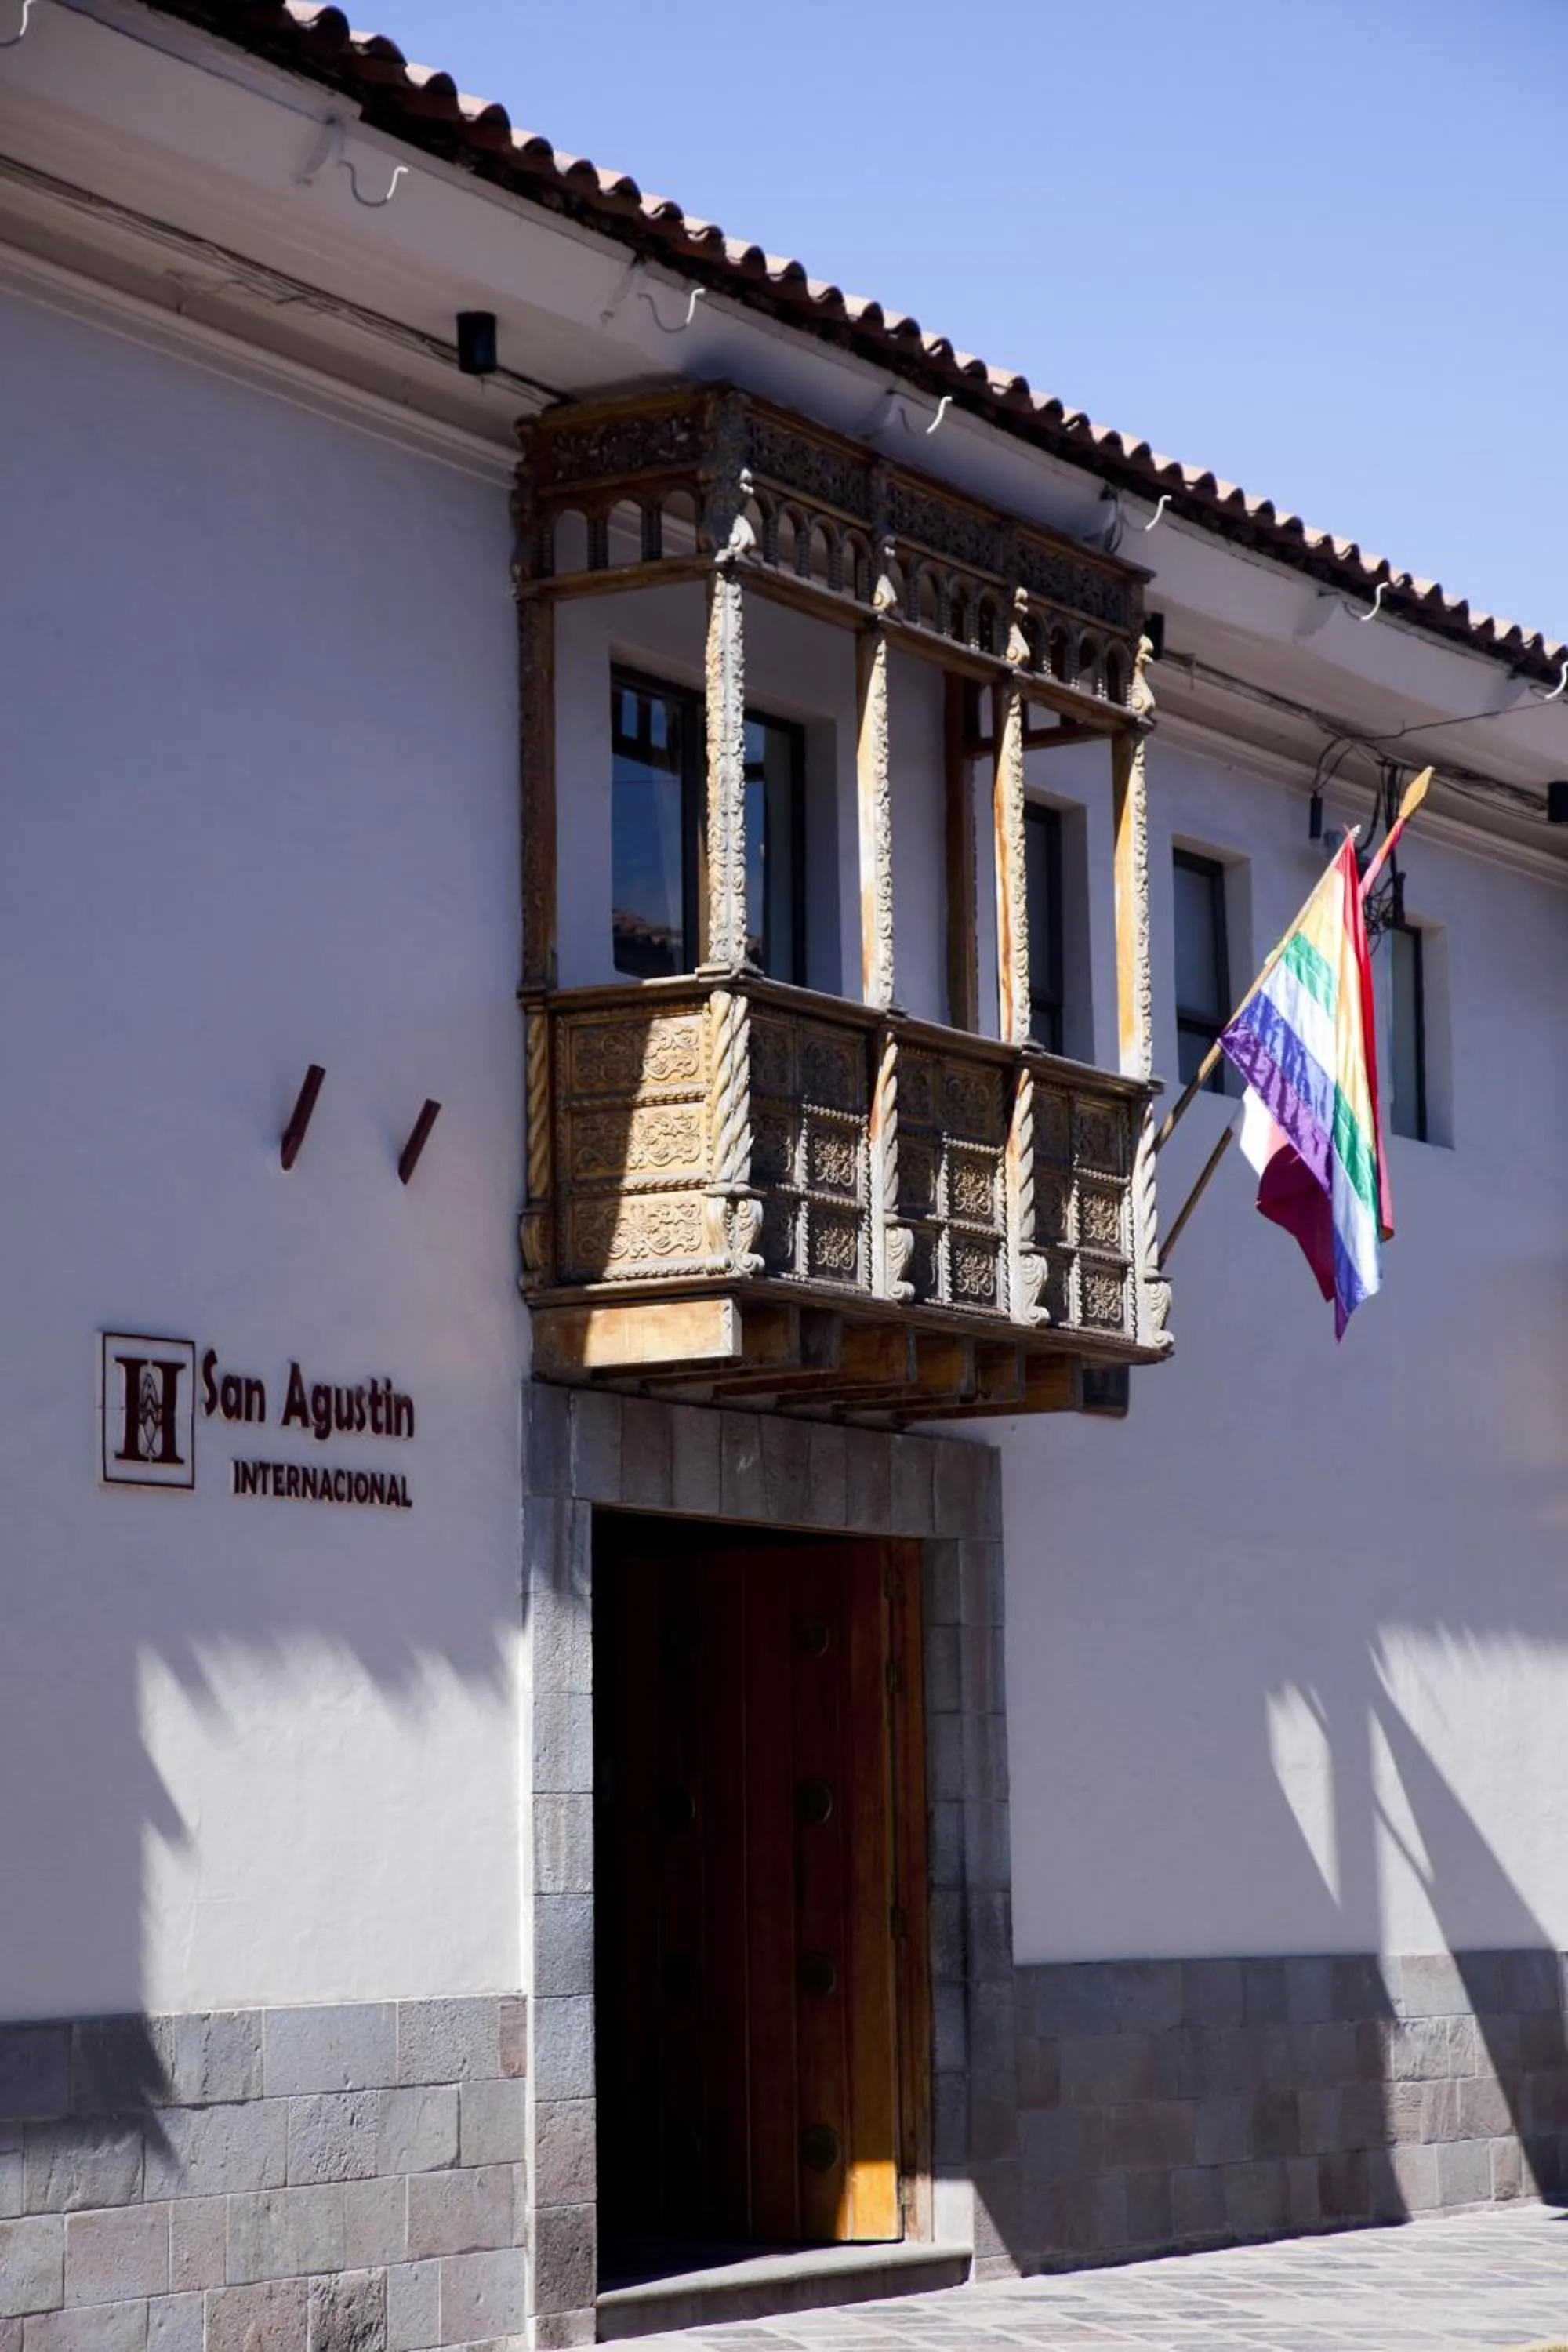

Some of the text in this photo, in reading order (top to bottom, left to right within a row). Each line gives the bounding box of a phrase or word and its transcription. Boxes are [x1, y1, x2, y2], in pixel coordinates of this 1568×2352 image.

[203, 1348, 416, 1440] San Agustin
[234, 1460, 413, 1508] INTERNACIONAL
